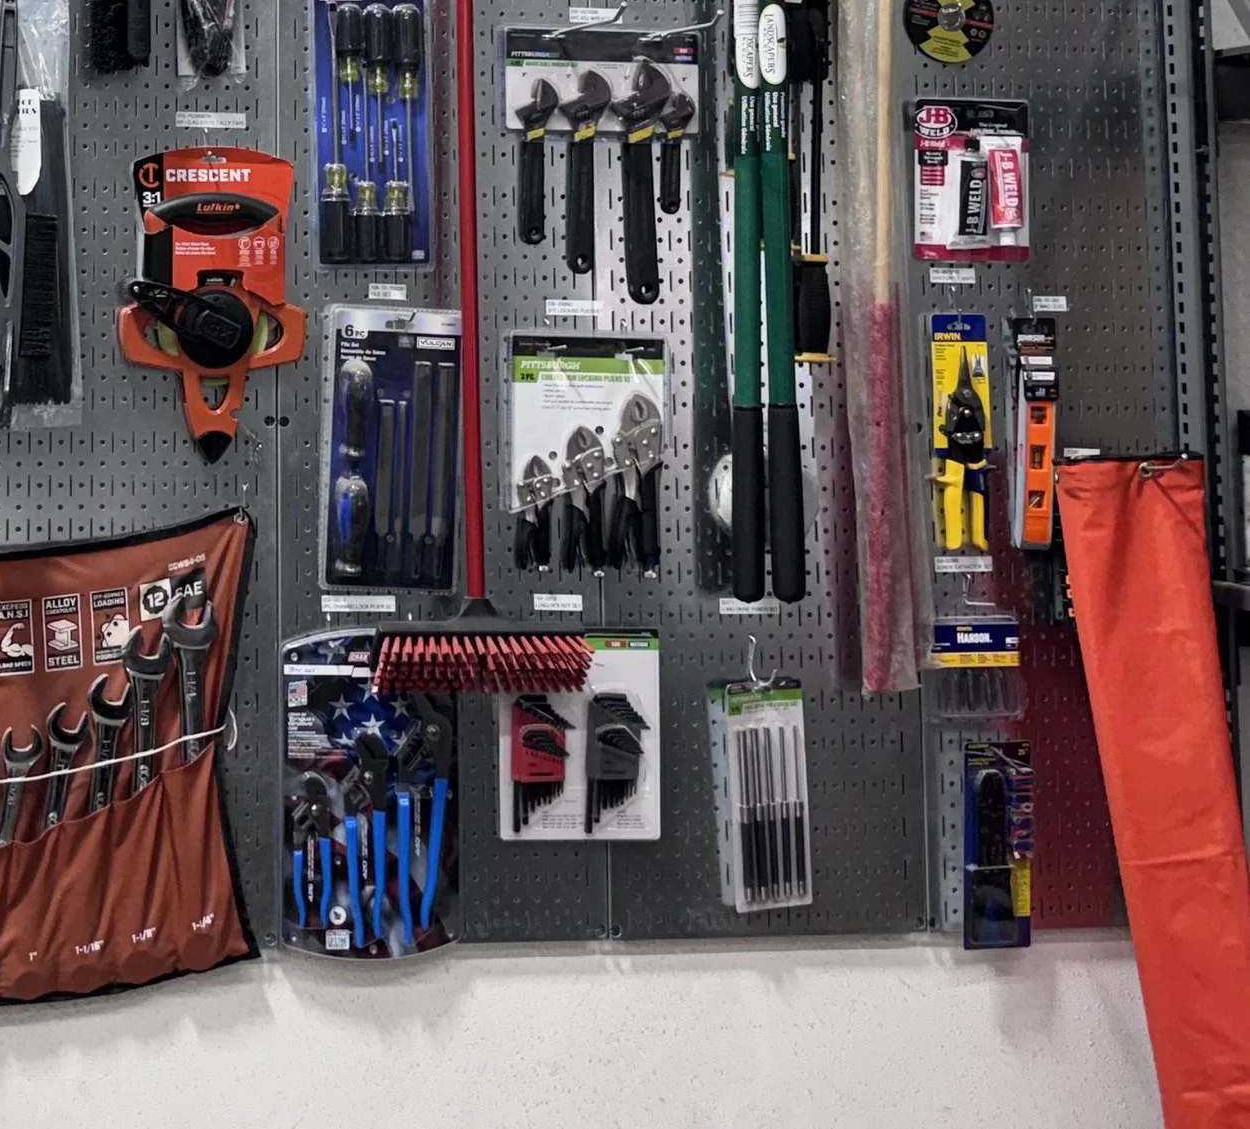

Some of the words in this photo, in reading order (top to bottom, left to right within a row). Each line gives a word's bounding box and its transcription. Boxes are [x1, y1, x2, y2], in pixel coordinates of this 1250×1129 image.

[763, 14, 776, 75] LANDSCAPERS
[919, 108, 949, 124] J-B
[919, 125, 949, 137] WELD
[1000, 152, 1014, 169] J-B
[165, 169, 251, 182] CRESCENT
[1002, 170, 1018, 207] WELD
[142, 192, 161, 203] 3:1
[968, 180, 983, 214] WELD
[965, 215, 979, 233] J-B
[345, 324, 354, 337] 6
[934, 332, 961, 341] IRWIN
[420, 339, 452, 348] VULCAN
[520, 360, 581, 370] PITTSBURGH
[45, 598, 76, 610] ALLOY
[94, 598, 124, 608] LOADING
[146, 593, 165, 607] 12
[956, 633, 990, 644] HANSON
[48, 655, 79, 666] STEEL
[140, 700, 150, 726] 1-1/8
[75, 940, 104, 955] 1-1/16"
[29, 951, 38, 962] 1"
